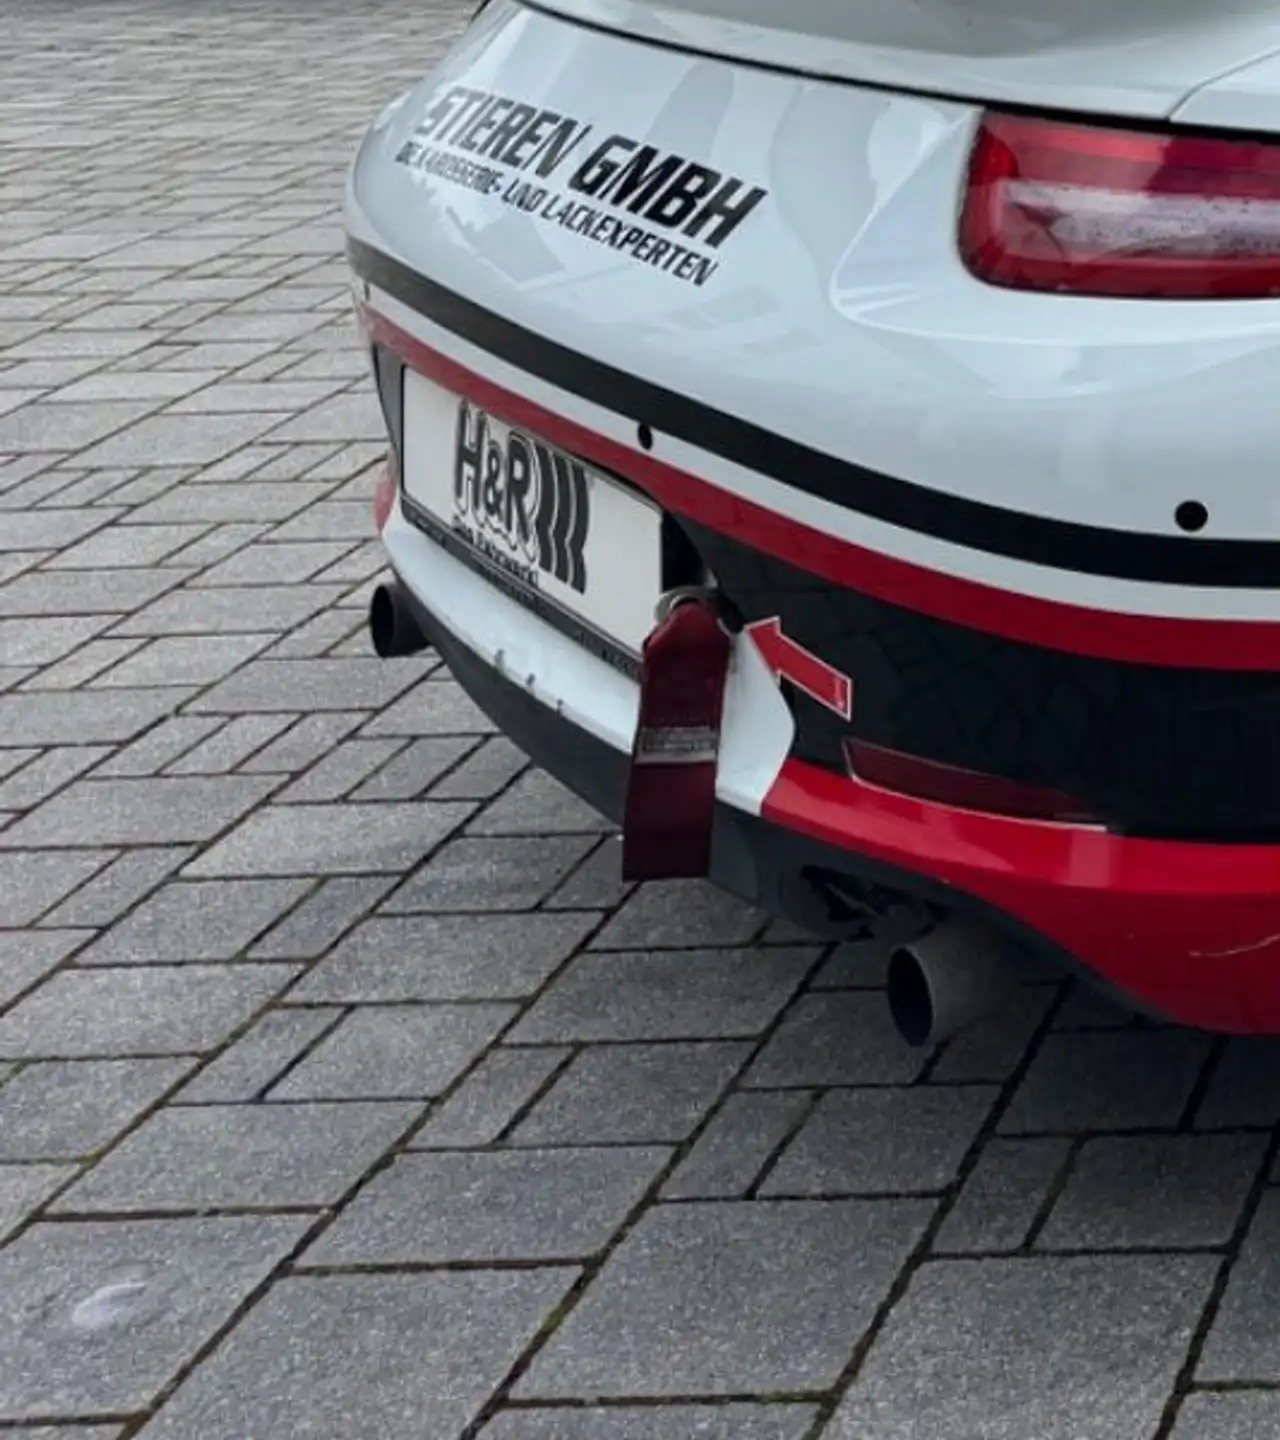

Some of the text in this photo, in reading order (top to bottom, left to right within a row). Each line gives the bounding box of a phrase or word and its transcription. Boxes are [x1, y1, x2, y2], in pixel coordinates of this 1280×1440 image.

[416, 84, 769, 249] STIEREN GMBH
[541, 192, 720, 288] LACKEXPERTEN
[453, 395, 550, 563] H&R
